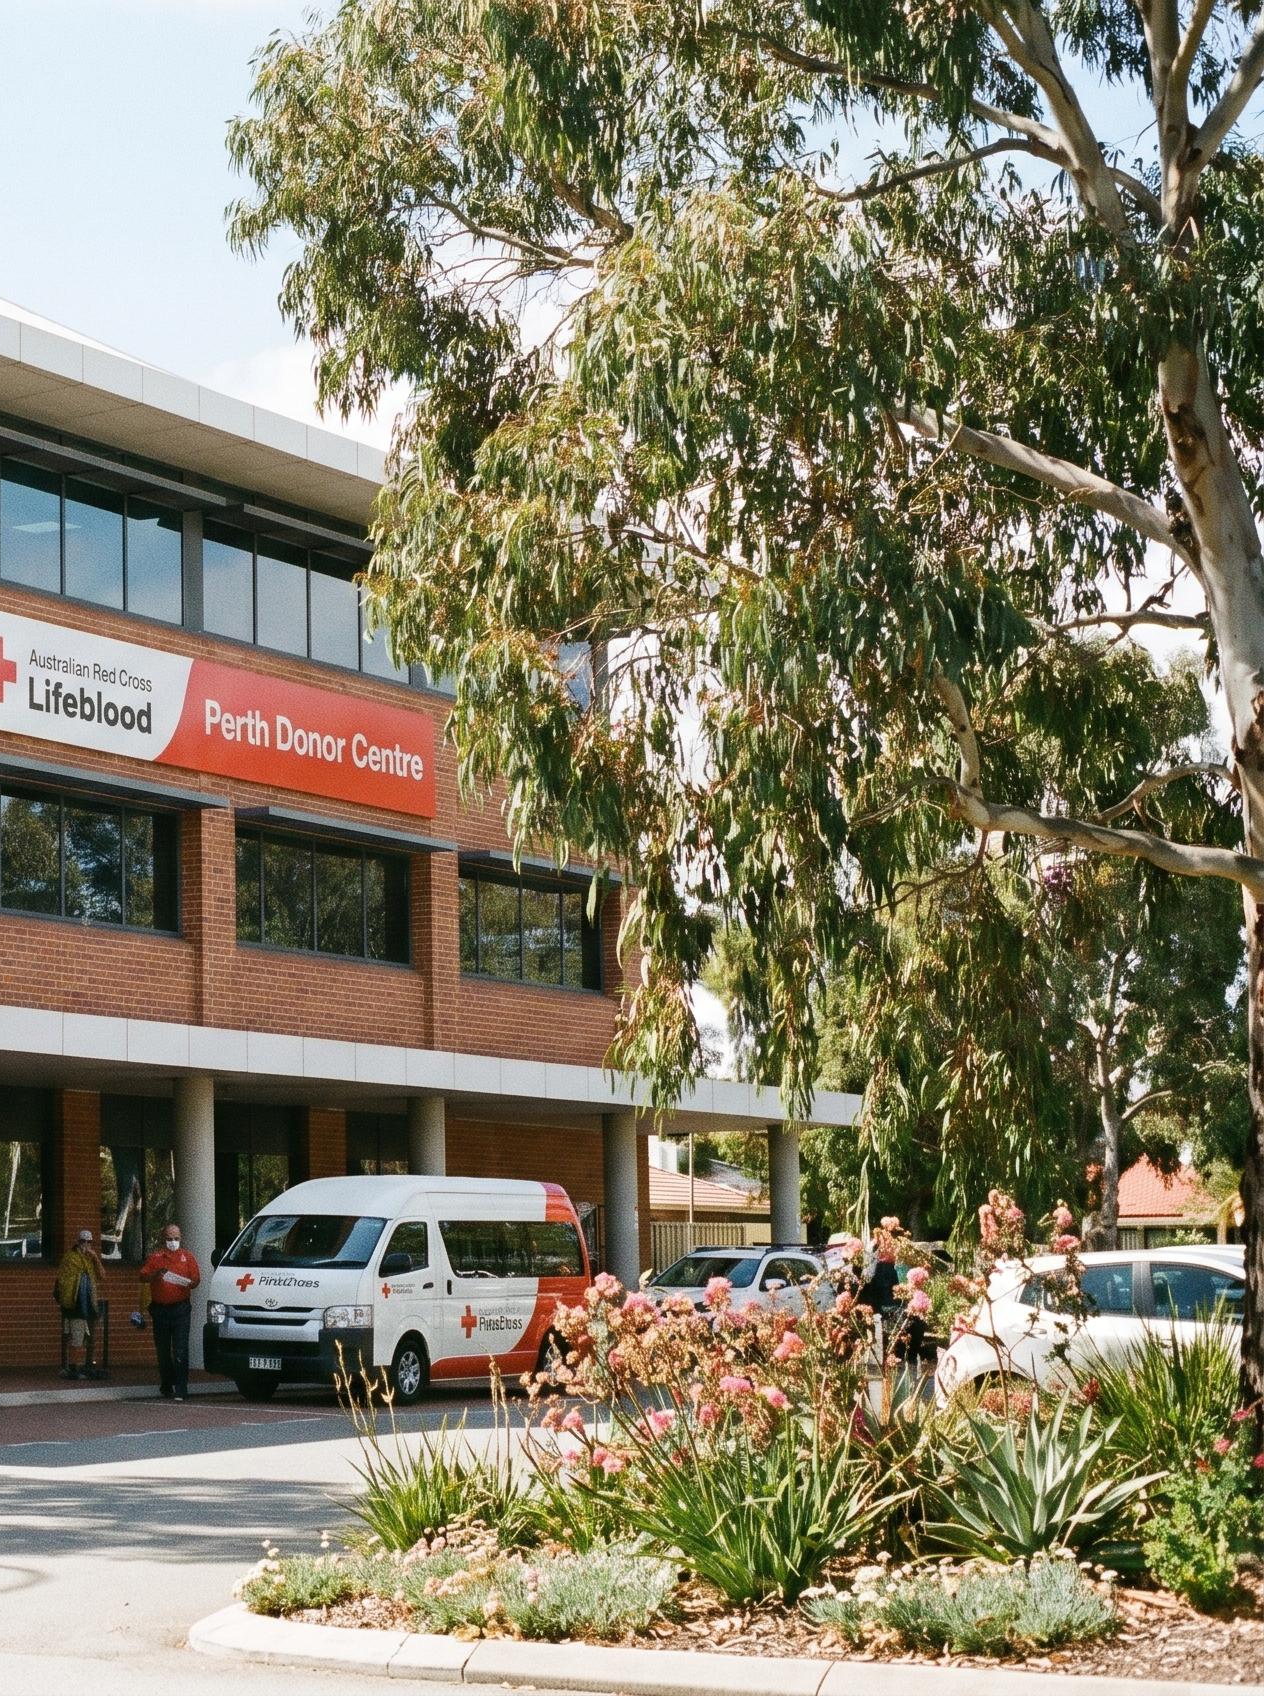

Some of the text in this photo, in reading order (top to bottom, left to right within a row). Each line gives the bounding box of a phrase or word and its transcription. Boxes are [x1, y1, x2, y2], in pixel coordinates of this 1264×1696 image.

[29, 649, 152, 693] Australian Red Cross
[28, 676, 152, 734] Lifeblood
[205, 698, 424, 781] Perth Donor Centre
